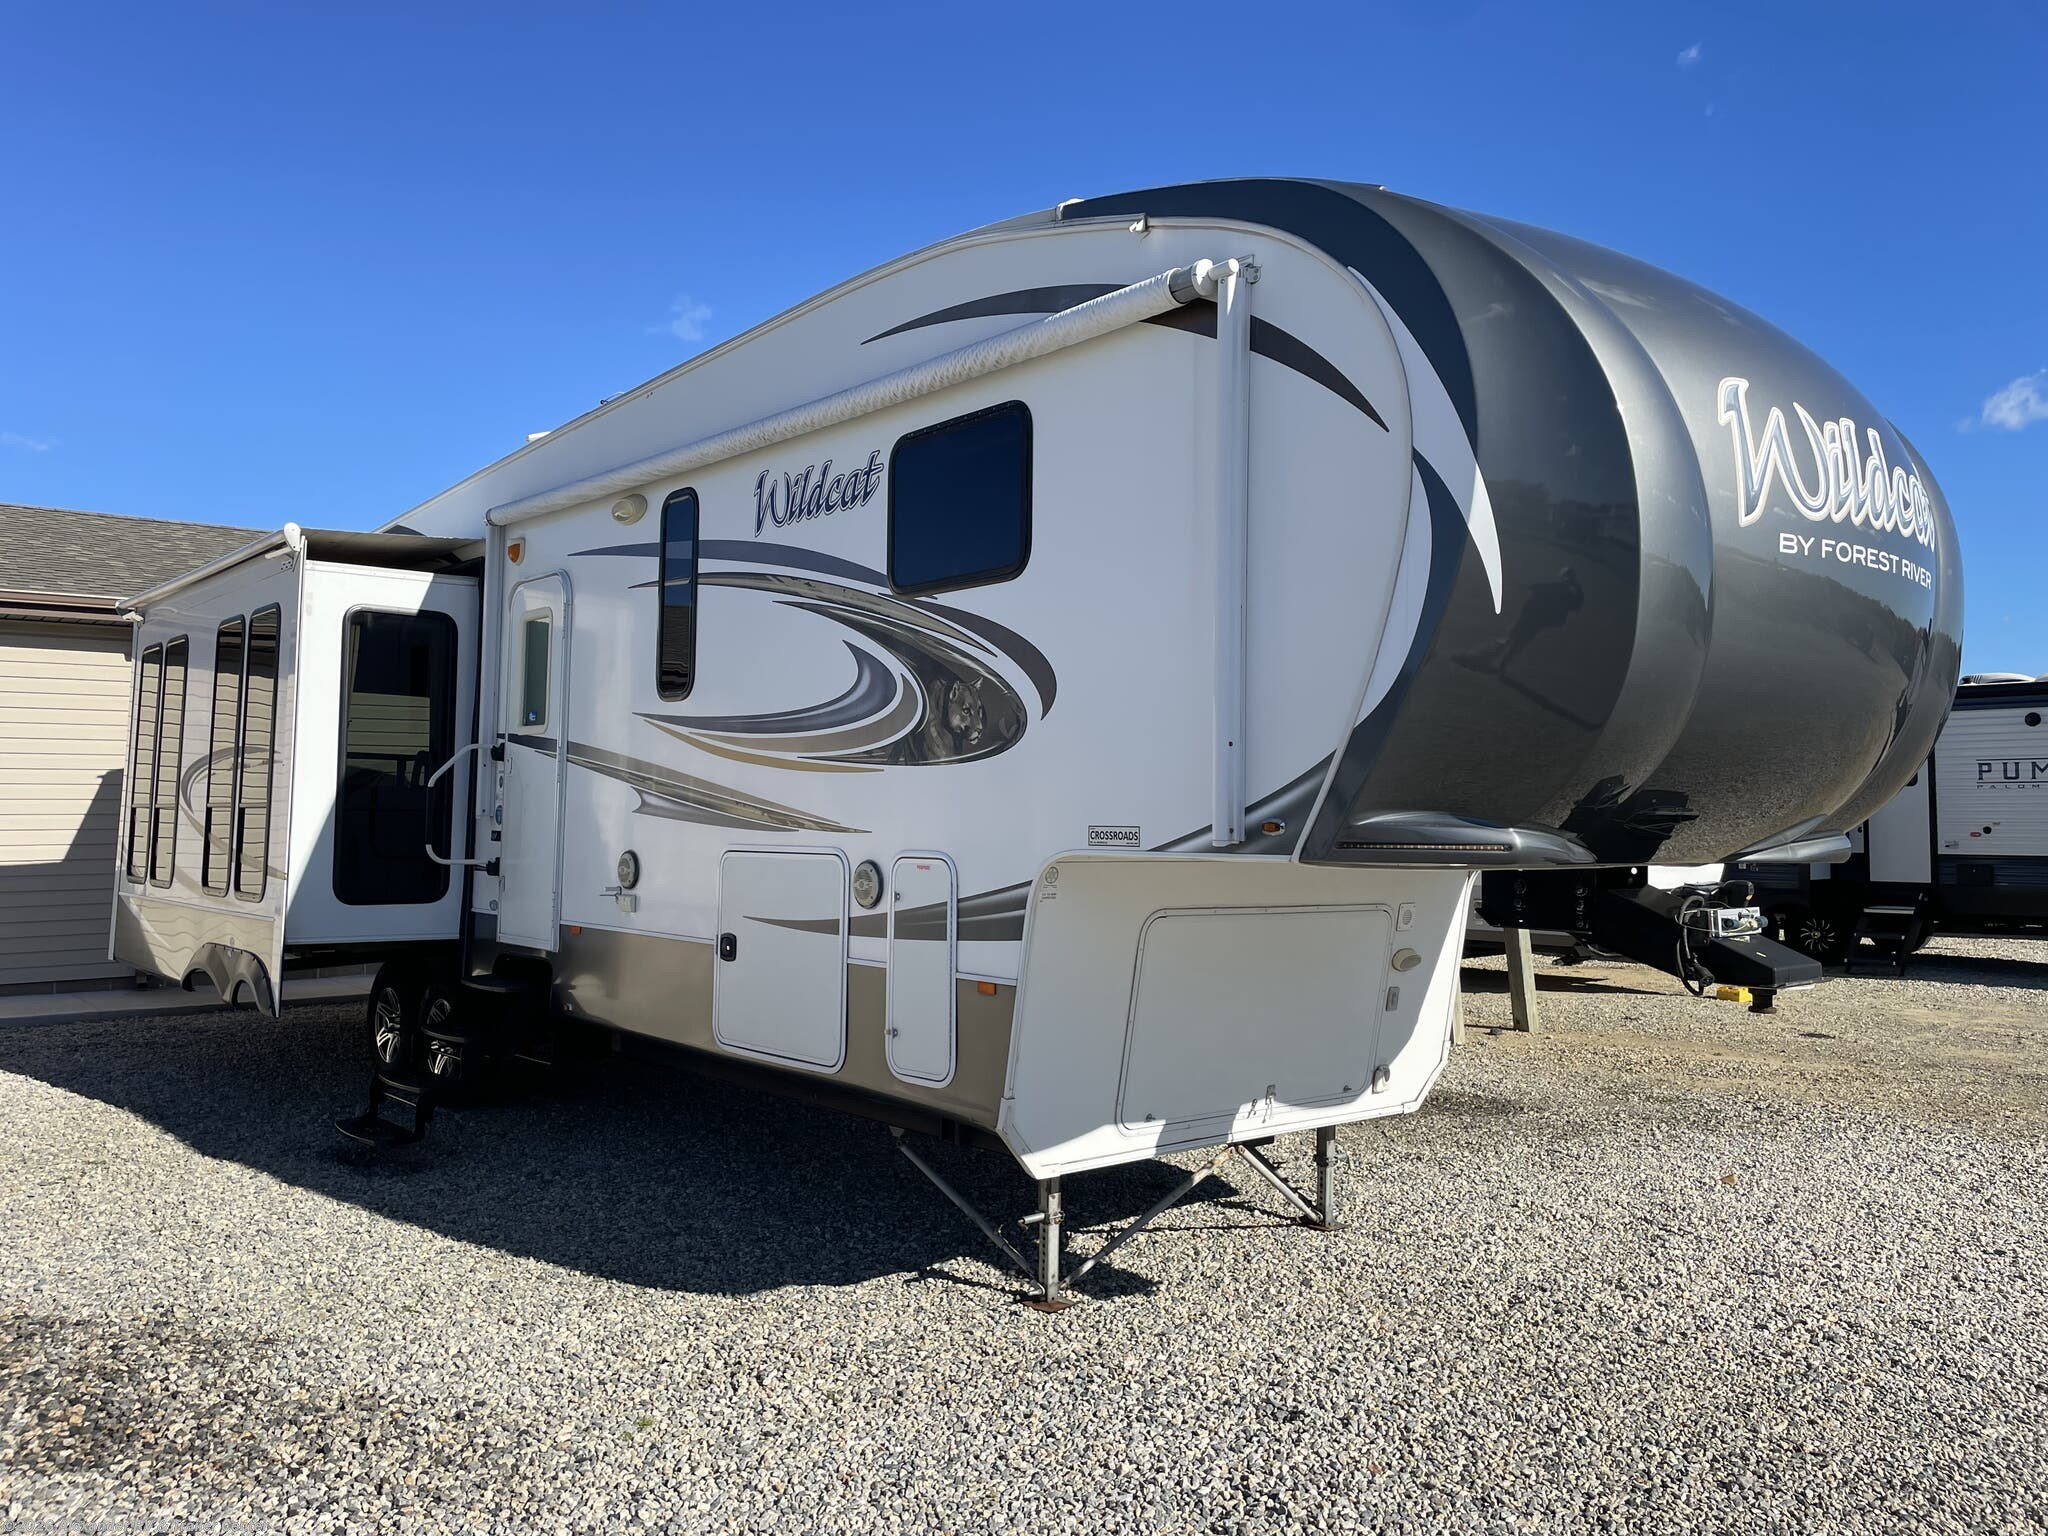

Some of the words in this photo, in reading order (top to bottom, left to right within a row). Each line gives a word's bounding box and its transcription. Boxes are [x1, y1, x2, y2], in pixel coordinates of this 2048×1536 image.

[753, 449, 885, 537] Wildcat
[1779, 533, 1815, 556] BY
[1821, 538, 1900, 574] FOREST
[1902, 558, 1932, 590] RIVER
[1977, 761, 2048, 781] PUM
[1090, 830, 1139, 841] CROSSROADS
